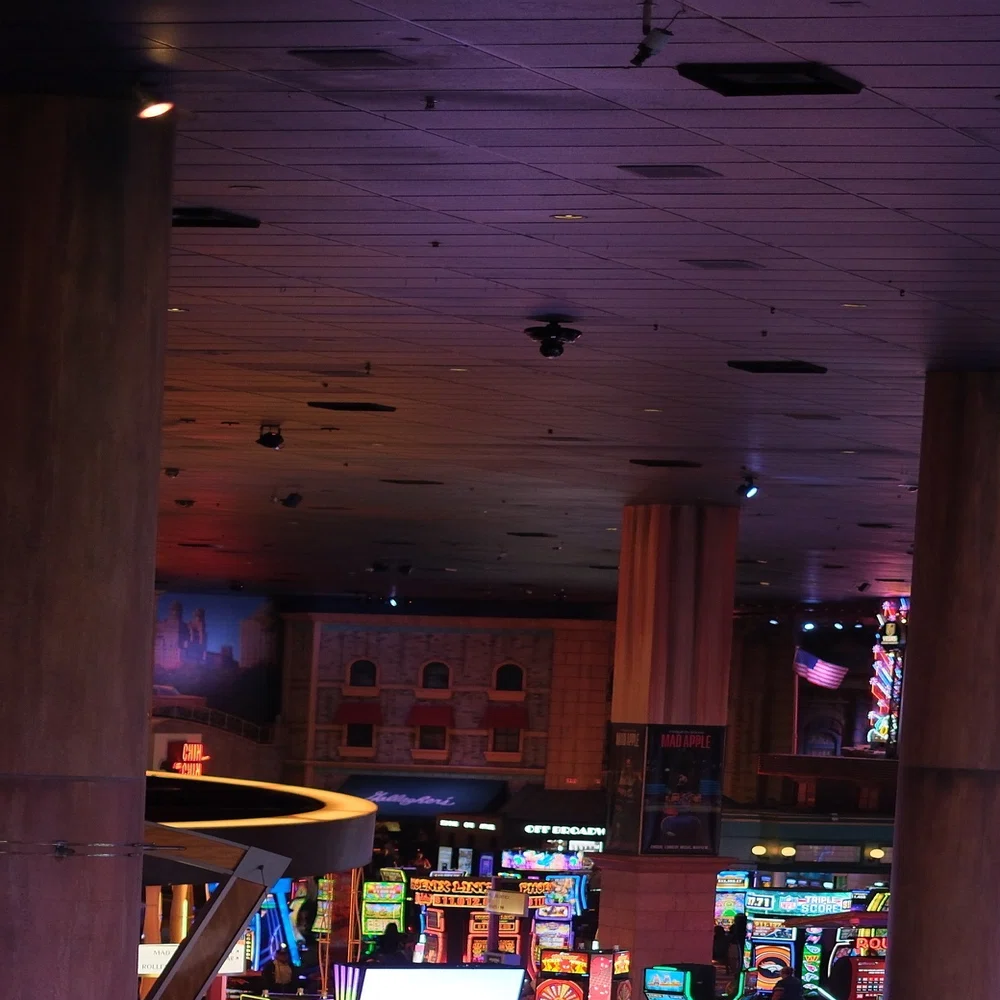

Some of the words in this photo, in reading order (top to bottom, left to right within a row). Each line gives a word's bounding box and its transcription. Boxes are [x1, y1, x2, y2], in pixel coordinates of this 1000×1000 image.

[661, 734, 683, 748] MAD
[684, 734, 712, 749] APPLE
[182, 743, 203, 761] CHIN
[524, 825, 551, 834] OFF
[805, 895, 837, 904] TRIPLE
[801, 904, 839, 913] SCORE
